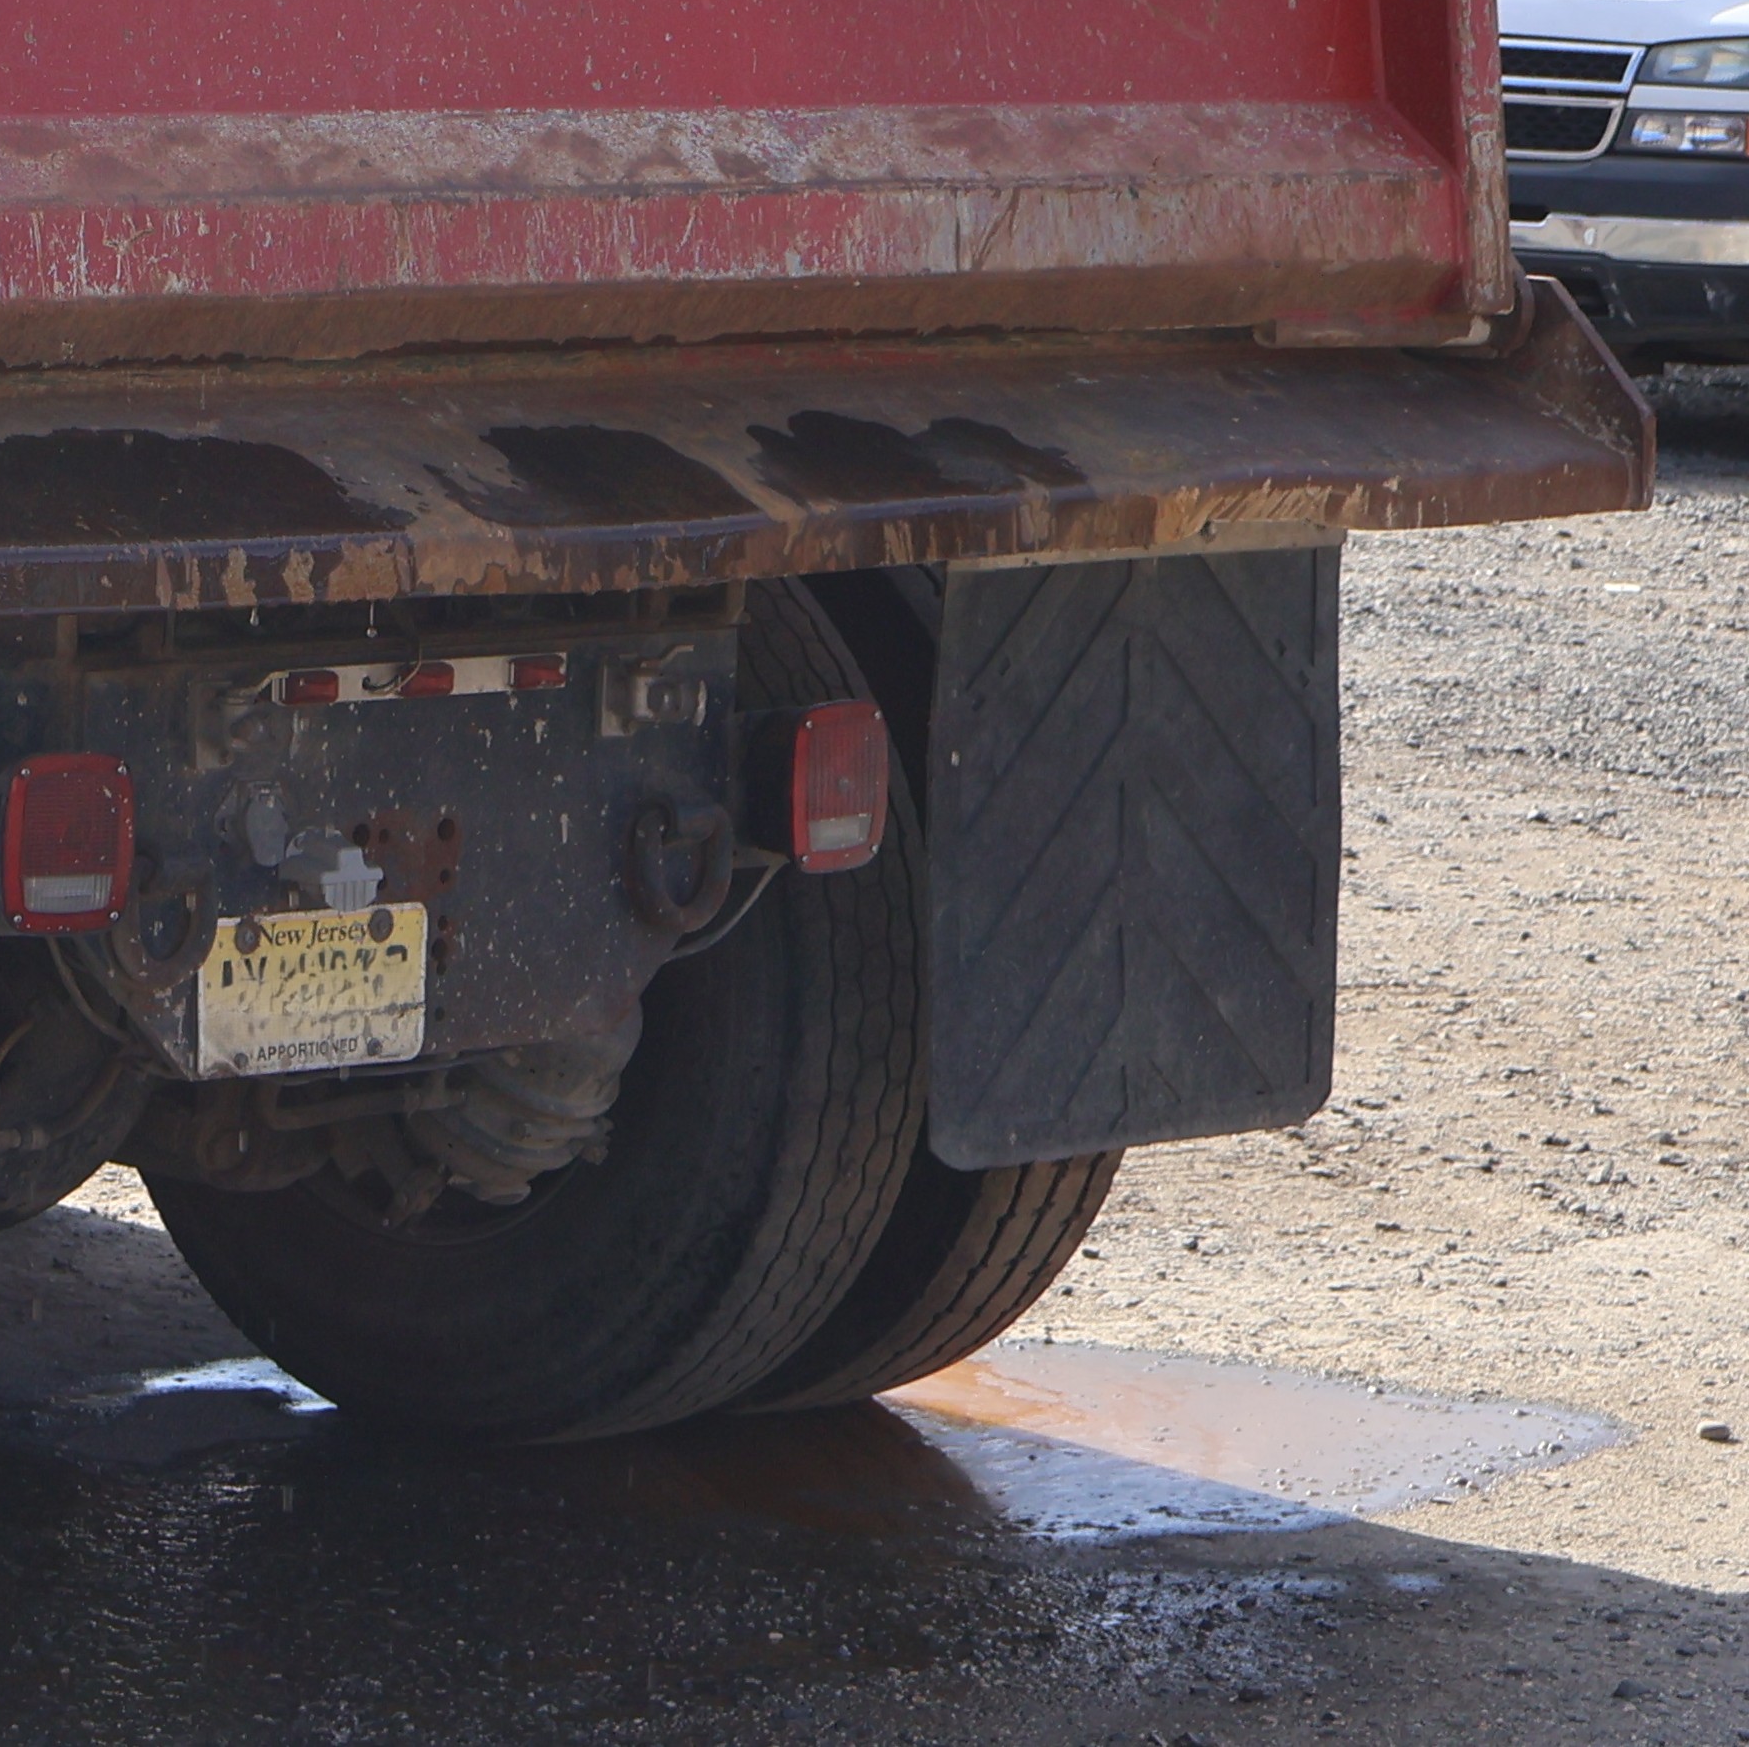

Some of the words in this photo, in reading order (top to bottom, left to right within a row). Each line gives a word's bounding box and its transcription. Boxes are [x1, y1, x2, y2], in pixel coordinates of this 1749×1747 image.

[259, 923, 304, 947] New
[306, 920, 369, 949] Jersey
[256, 1037, 358, 1062] APPORTIONED
